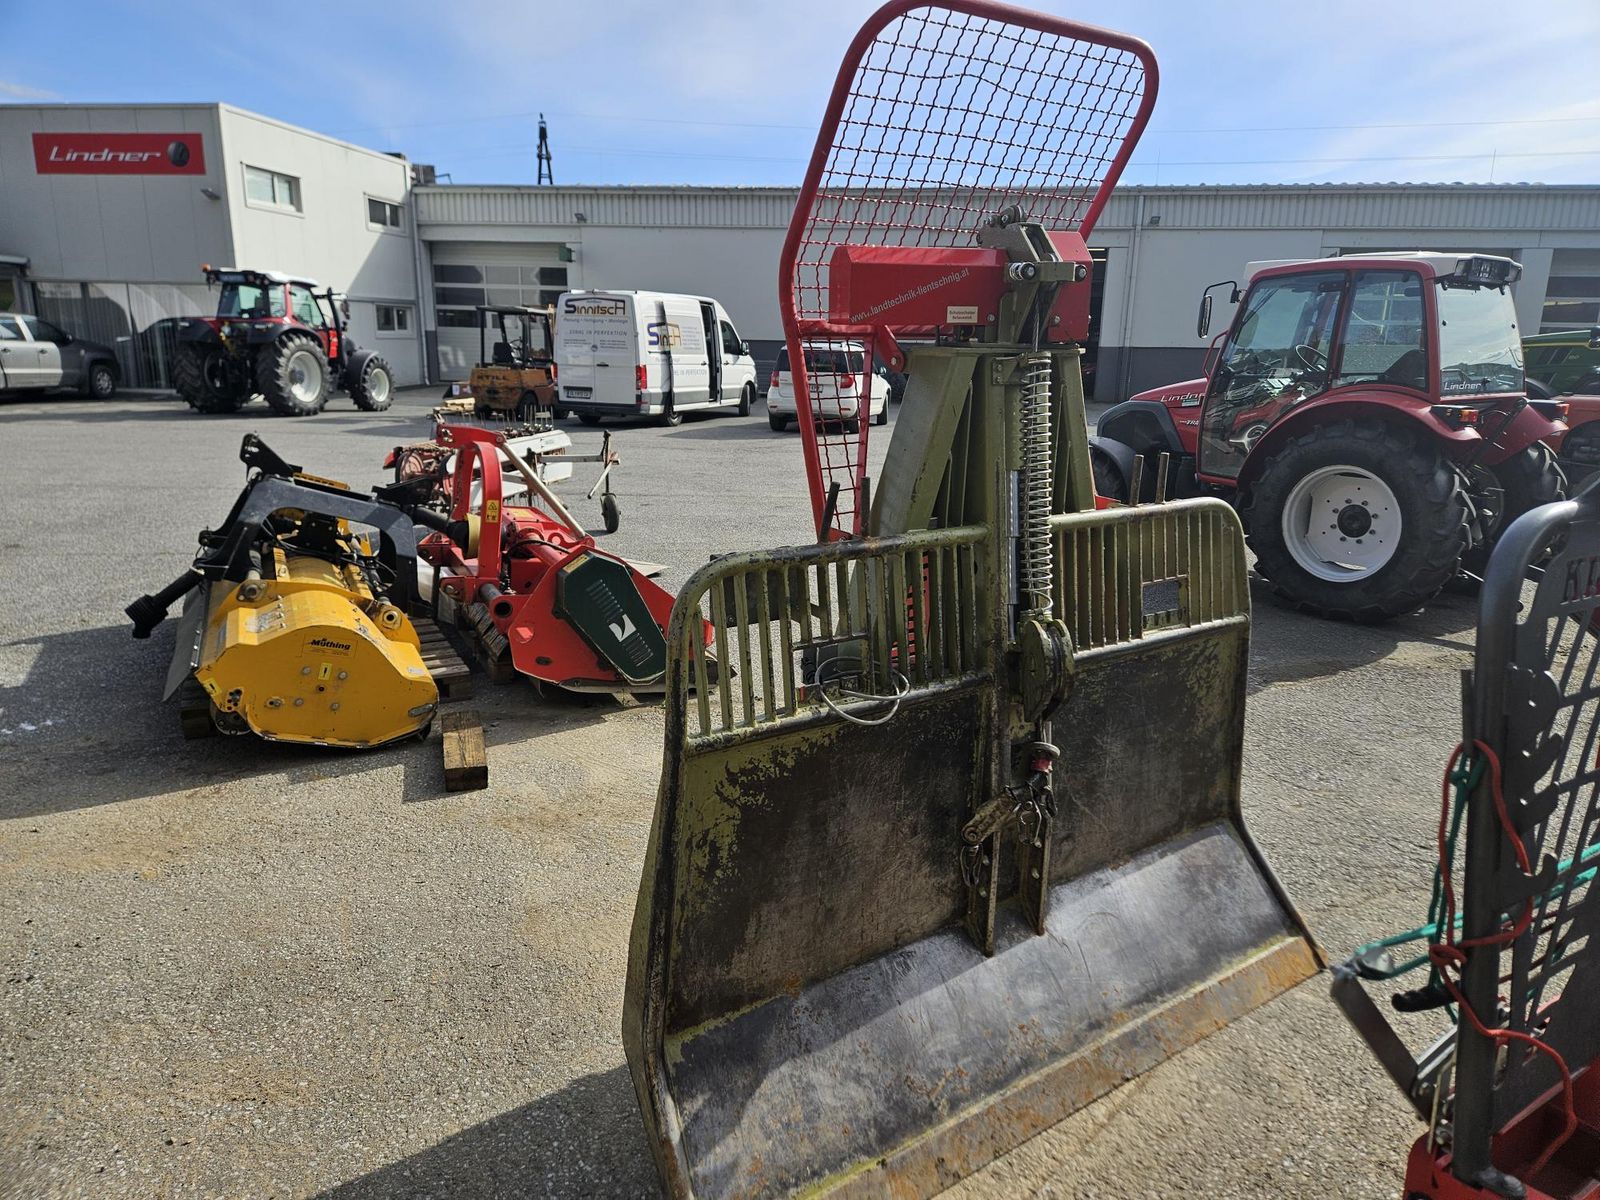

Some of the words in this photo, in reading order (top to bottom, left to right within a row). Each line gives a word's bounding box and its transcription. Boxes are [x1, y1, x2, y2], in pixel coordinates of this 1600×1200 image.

[49, 146, 161, 162] Lindner
[849, 268, 970, 323] www.landtechnik-lientschnig.at
[1444, 381, 1482, 390] Lindner
[311, 638, 351, 650] Müthing
